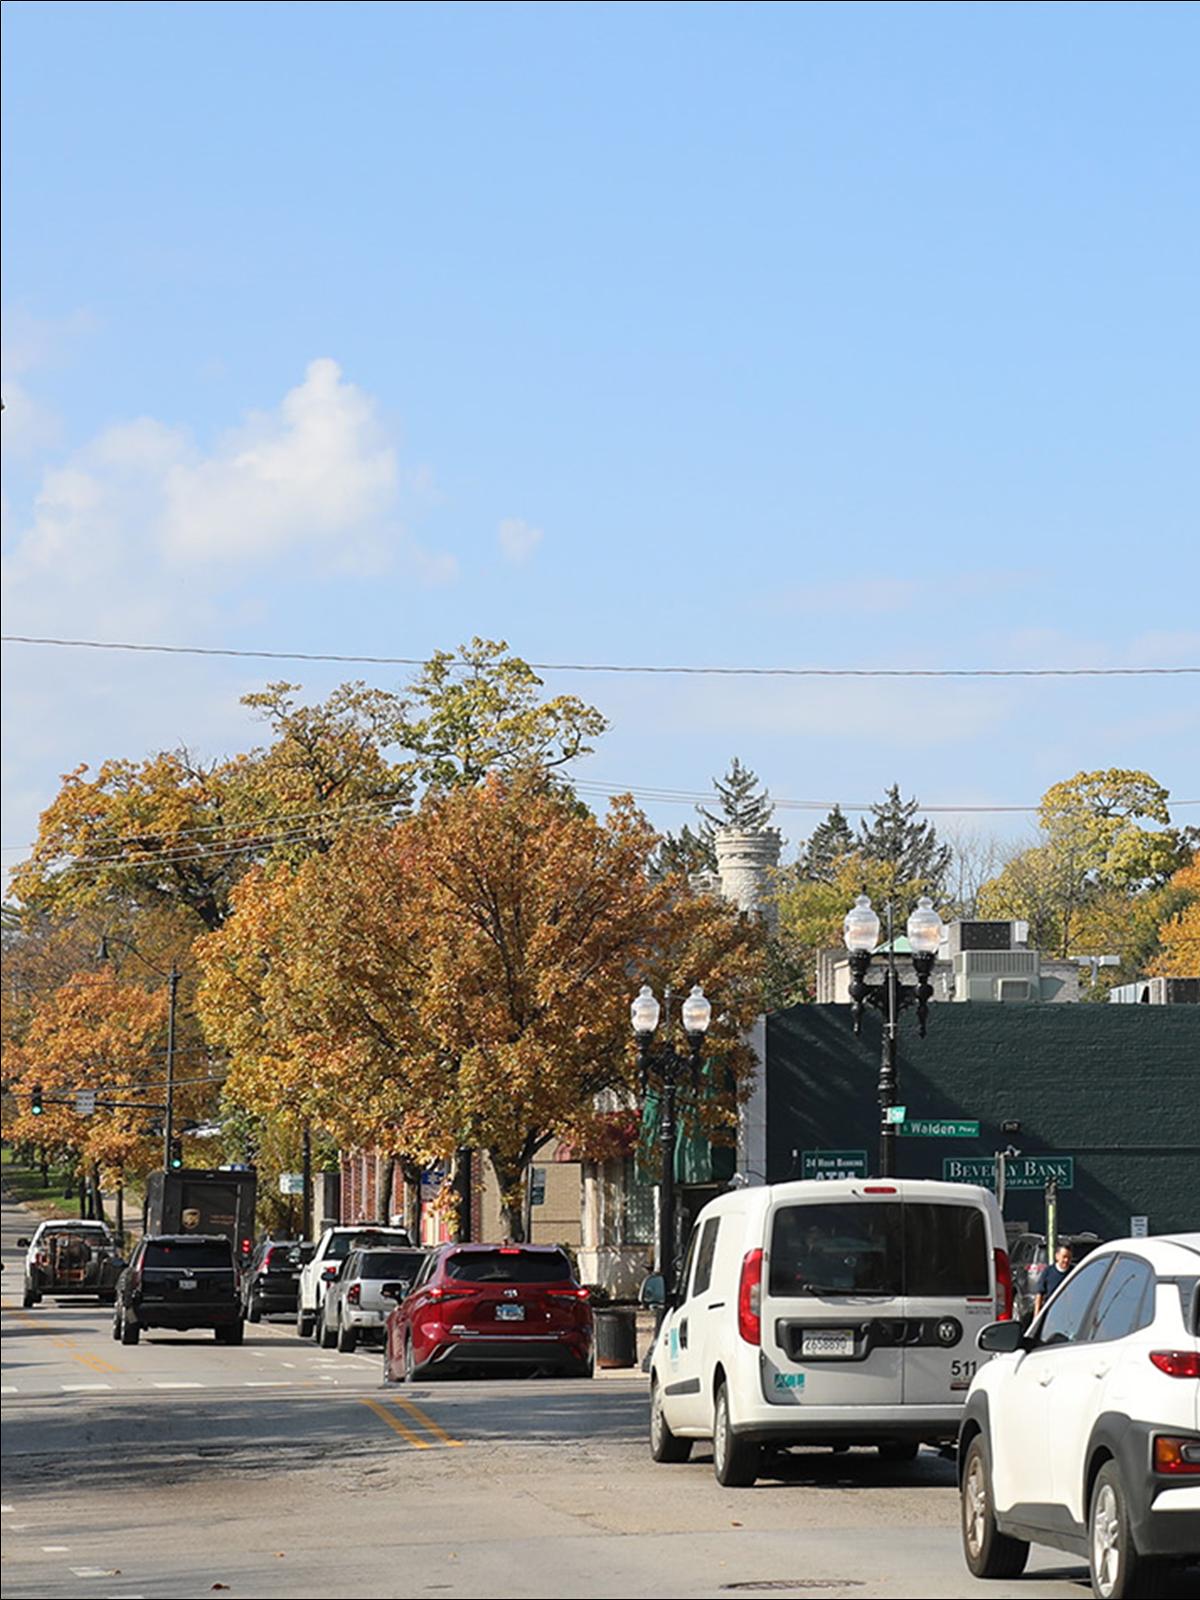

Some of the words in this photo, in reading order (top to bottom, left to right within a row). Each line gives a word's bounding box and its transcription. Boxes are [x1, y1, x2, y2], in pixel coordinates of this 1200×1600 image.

[911, 1122, 956, 1134] Walden
[806, 1158, 816, 1168] 24
[950, 1161, 1019, 1177] BEVEY
[1024, 1161, 1067, 1176] BANK
[951, 1360, 977, 1376] 511
